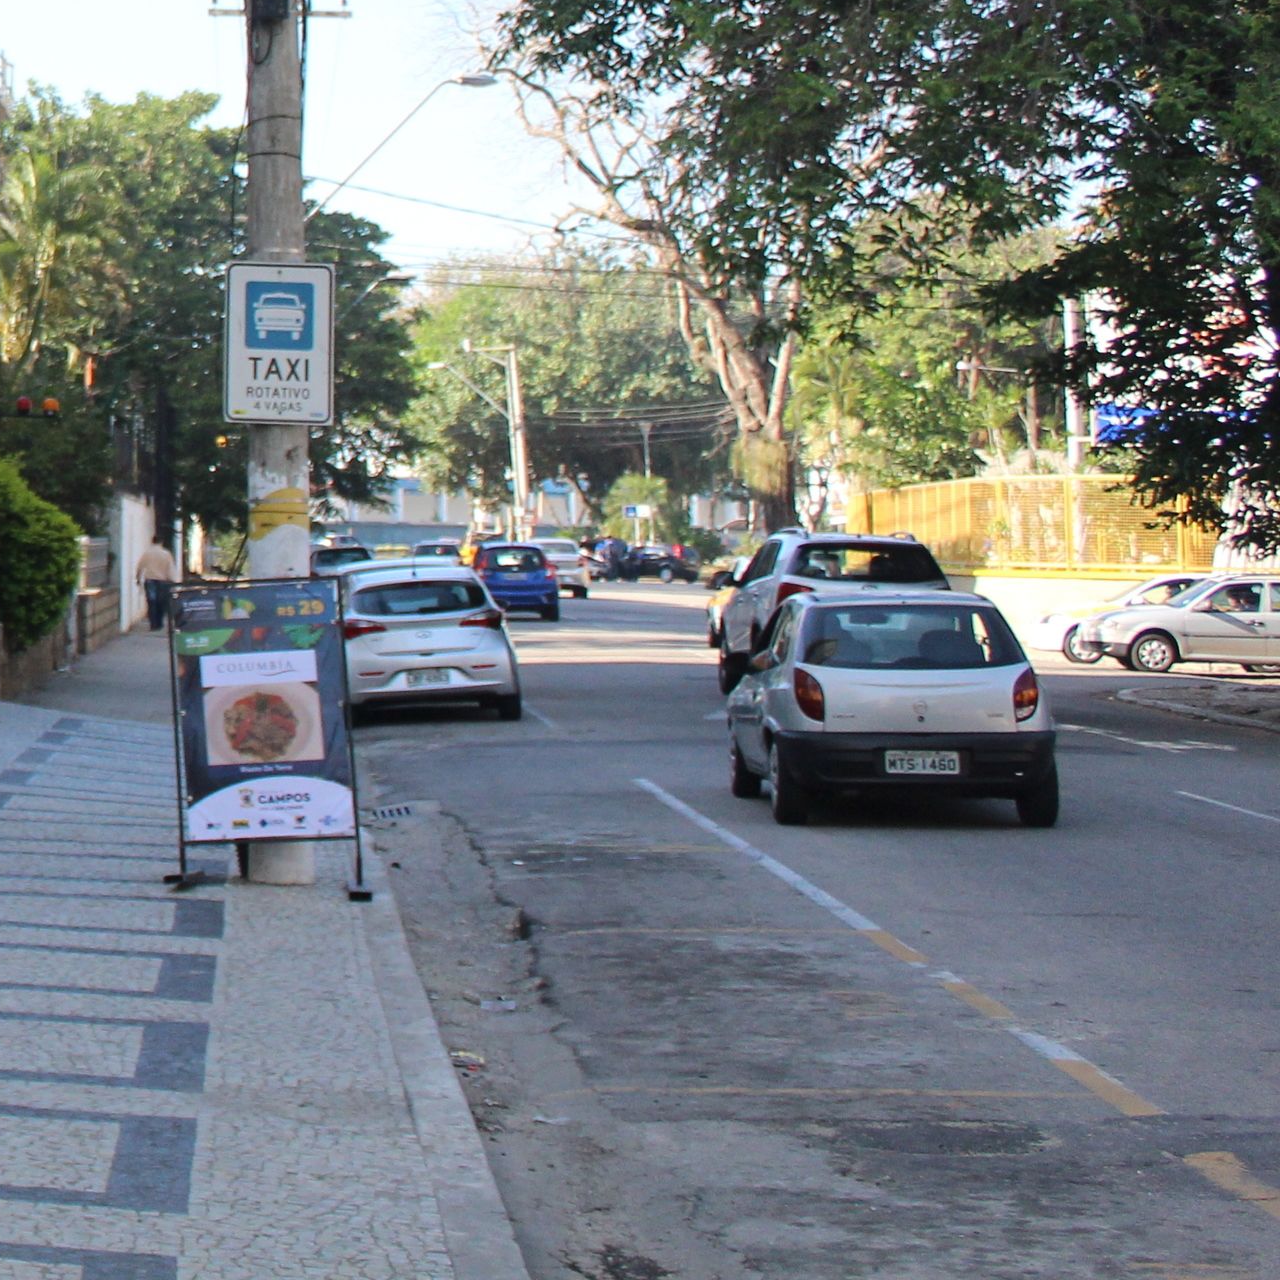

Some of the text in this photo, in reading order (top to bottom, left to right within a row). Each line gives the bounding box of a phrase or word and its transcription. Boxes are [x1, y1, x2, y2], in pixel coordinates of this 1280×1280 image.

[248, 357, 310, 382] TAXI
[246, 386, 310, 400] ROTATIVO
[265, 402, 302, 412] VAGAS
[298, 598, 326, 616] 29
[257, 792, 311, 805] CAMPOS
